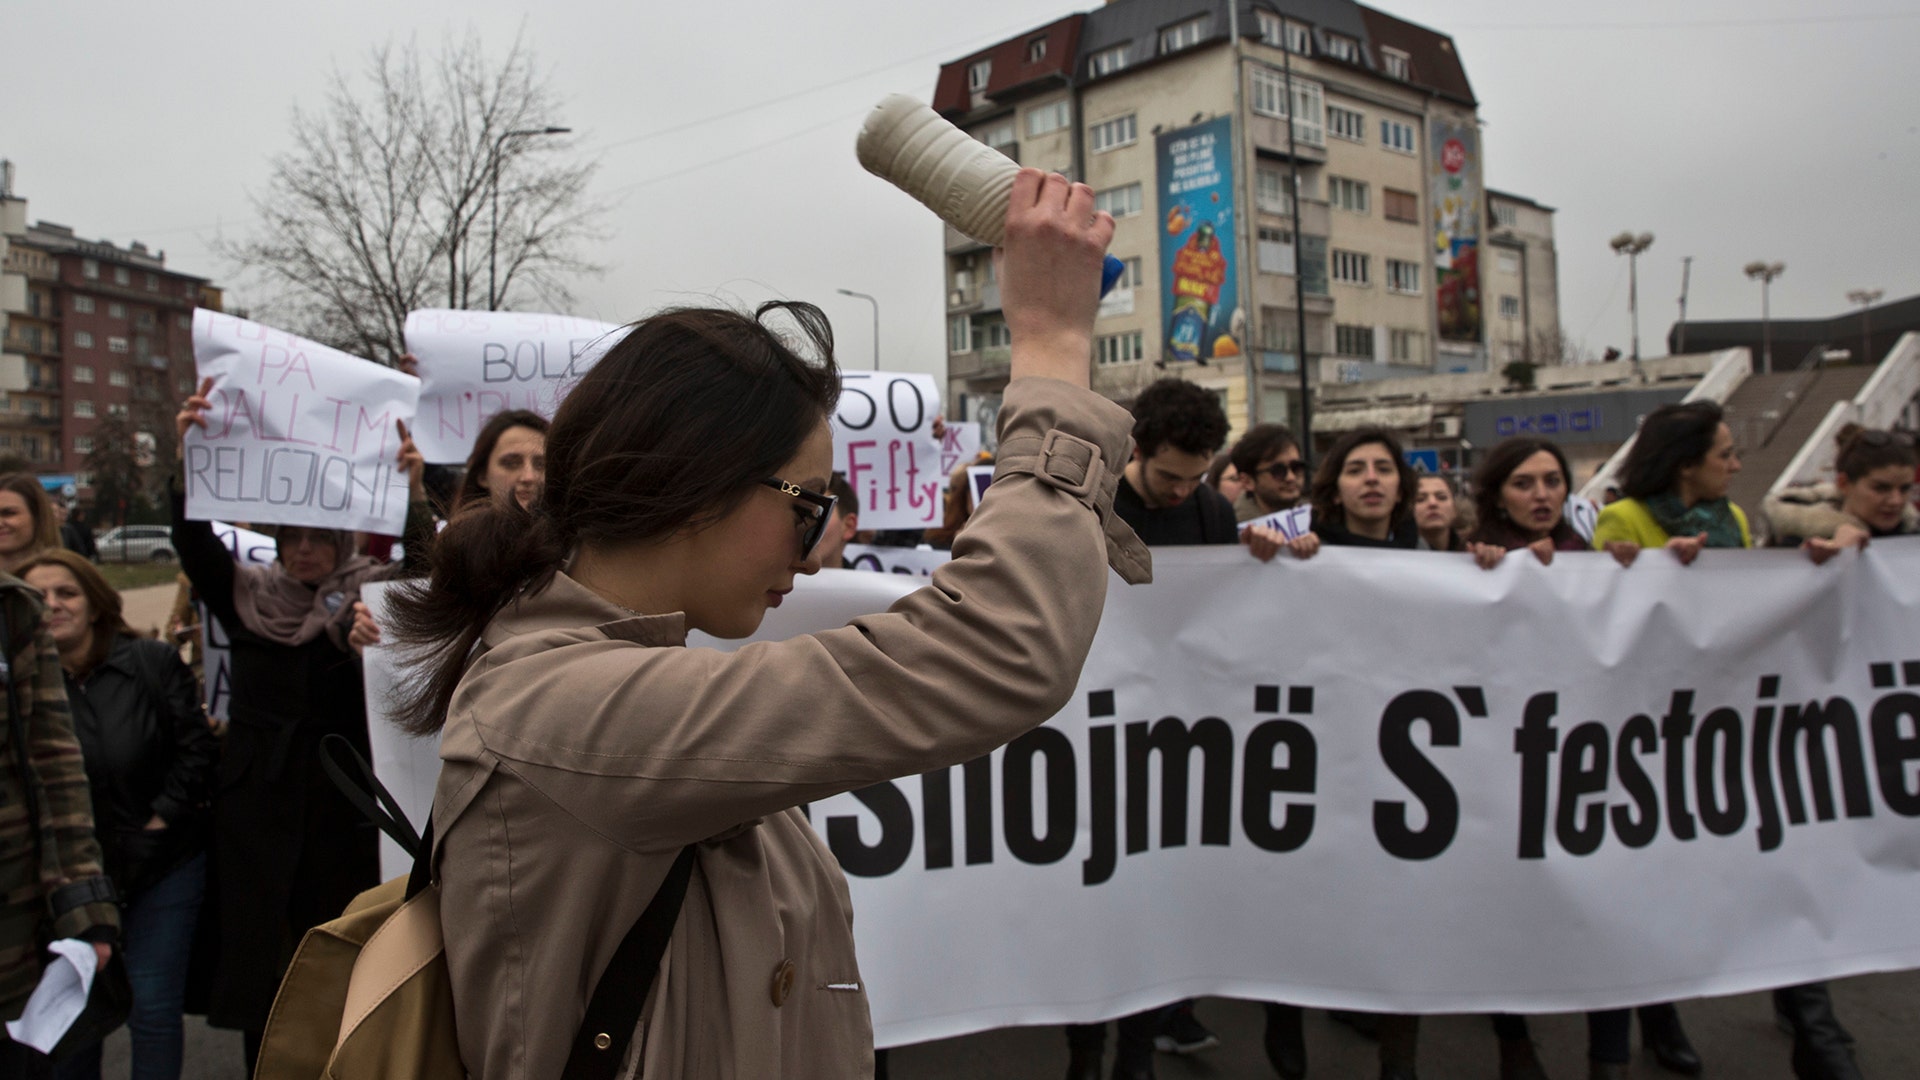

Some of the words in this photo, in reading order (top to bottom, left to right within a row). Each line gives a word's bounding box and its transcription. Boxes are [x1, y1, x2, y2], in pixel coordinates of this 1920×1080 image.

[257, 344, 316, 391] PA
[837, 375, 924, 433] 50
[780, 480, 801, 497] D&G
[847, 439, 939, 522] Fifty
[1514, 660, 1920, 860] festojmë
